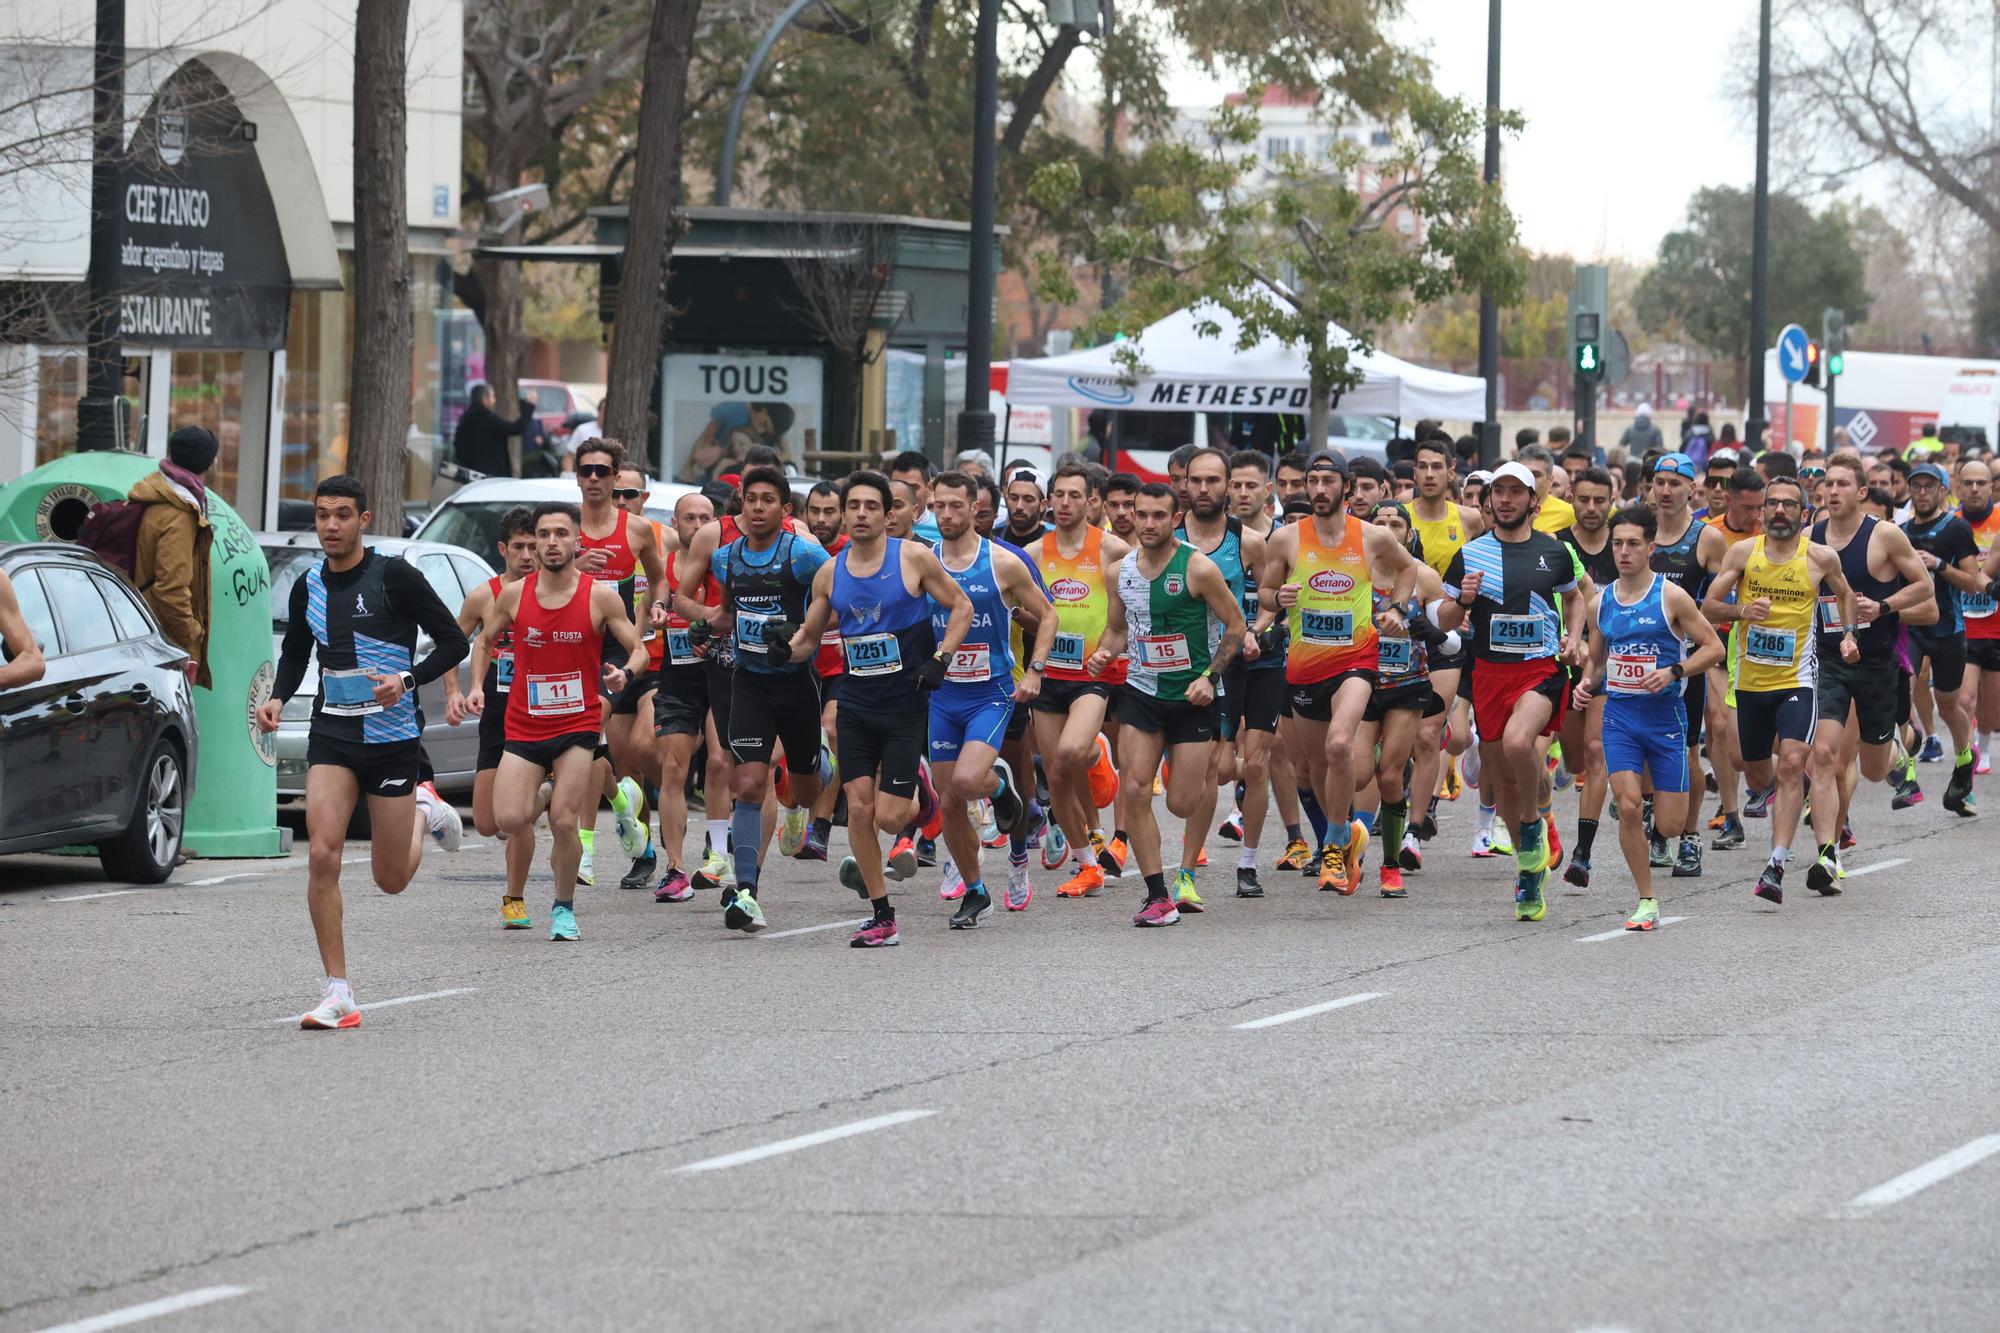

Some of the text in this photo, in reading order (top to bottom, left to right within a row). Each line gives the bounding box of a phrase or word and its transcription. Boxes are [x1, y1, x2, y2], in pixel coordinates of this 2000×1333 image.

[126, 184, 210, 228] CHE TANGO
[122, 237, 224, 276] ador argentino y tapas
[121, 296, 212, 335] ESTAURANTE
[699, 365, 788, 395] TOUS
[1150, 383, 1346, 410] METAESPOT
[1053, 585, 1086, 595] Serrano
[1313, 577, 1351, 588] Serrano
[1307, 615, 1344, 631] 2298
[1499, 622, 1535, 638] 2514
[553, 631, 583, 639] D FUSTA
[1753, 633, 1785, 652] 2186
[853, 641, 888, 660] 2251
[1155, 644, 1175, 657] 15
[957, 653, 977, 666] 27
[1615, 664, 1645, 678] 730
[550, 684, 568, 698] 11
